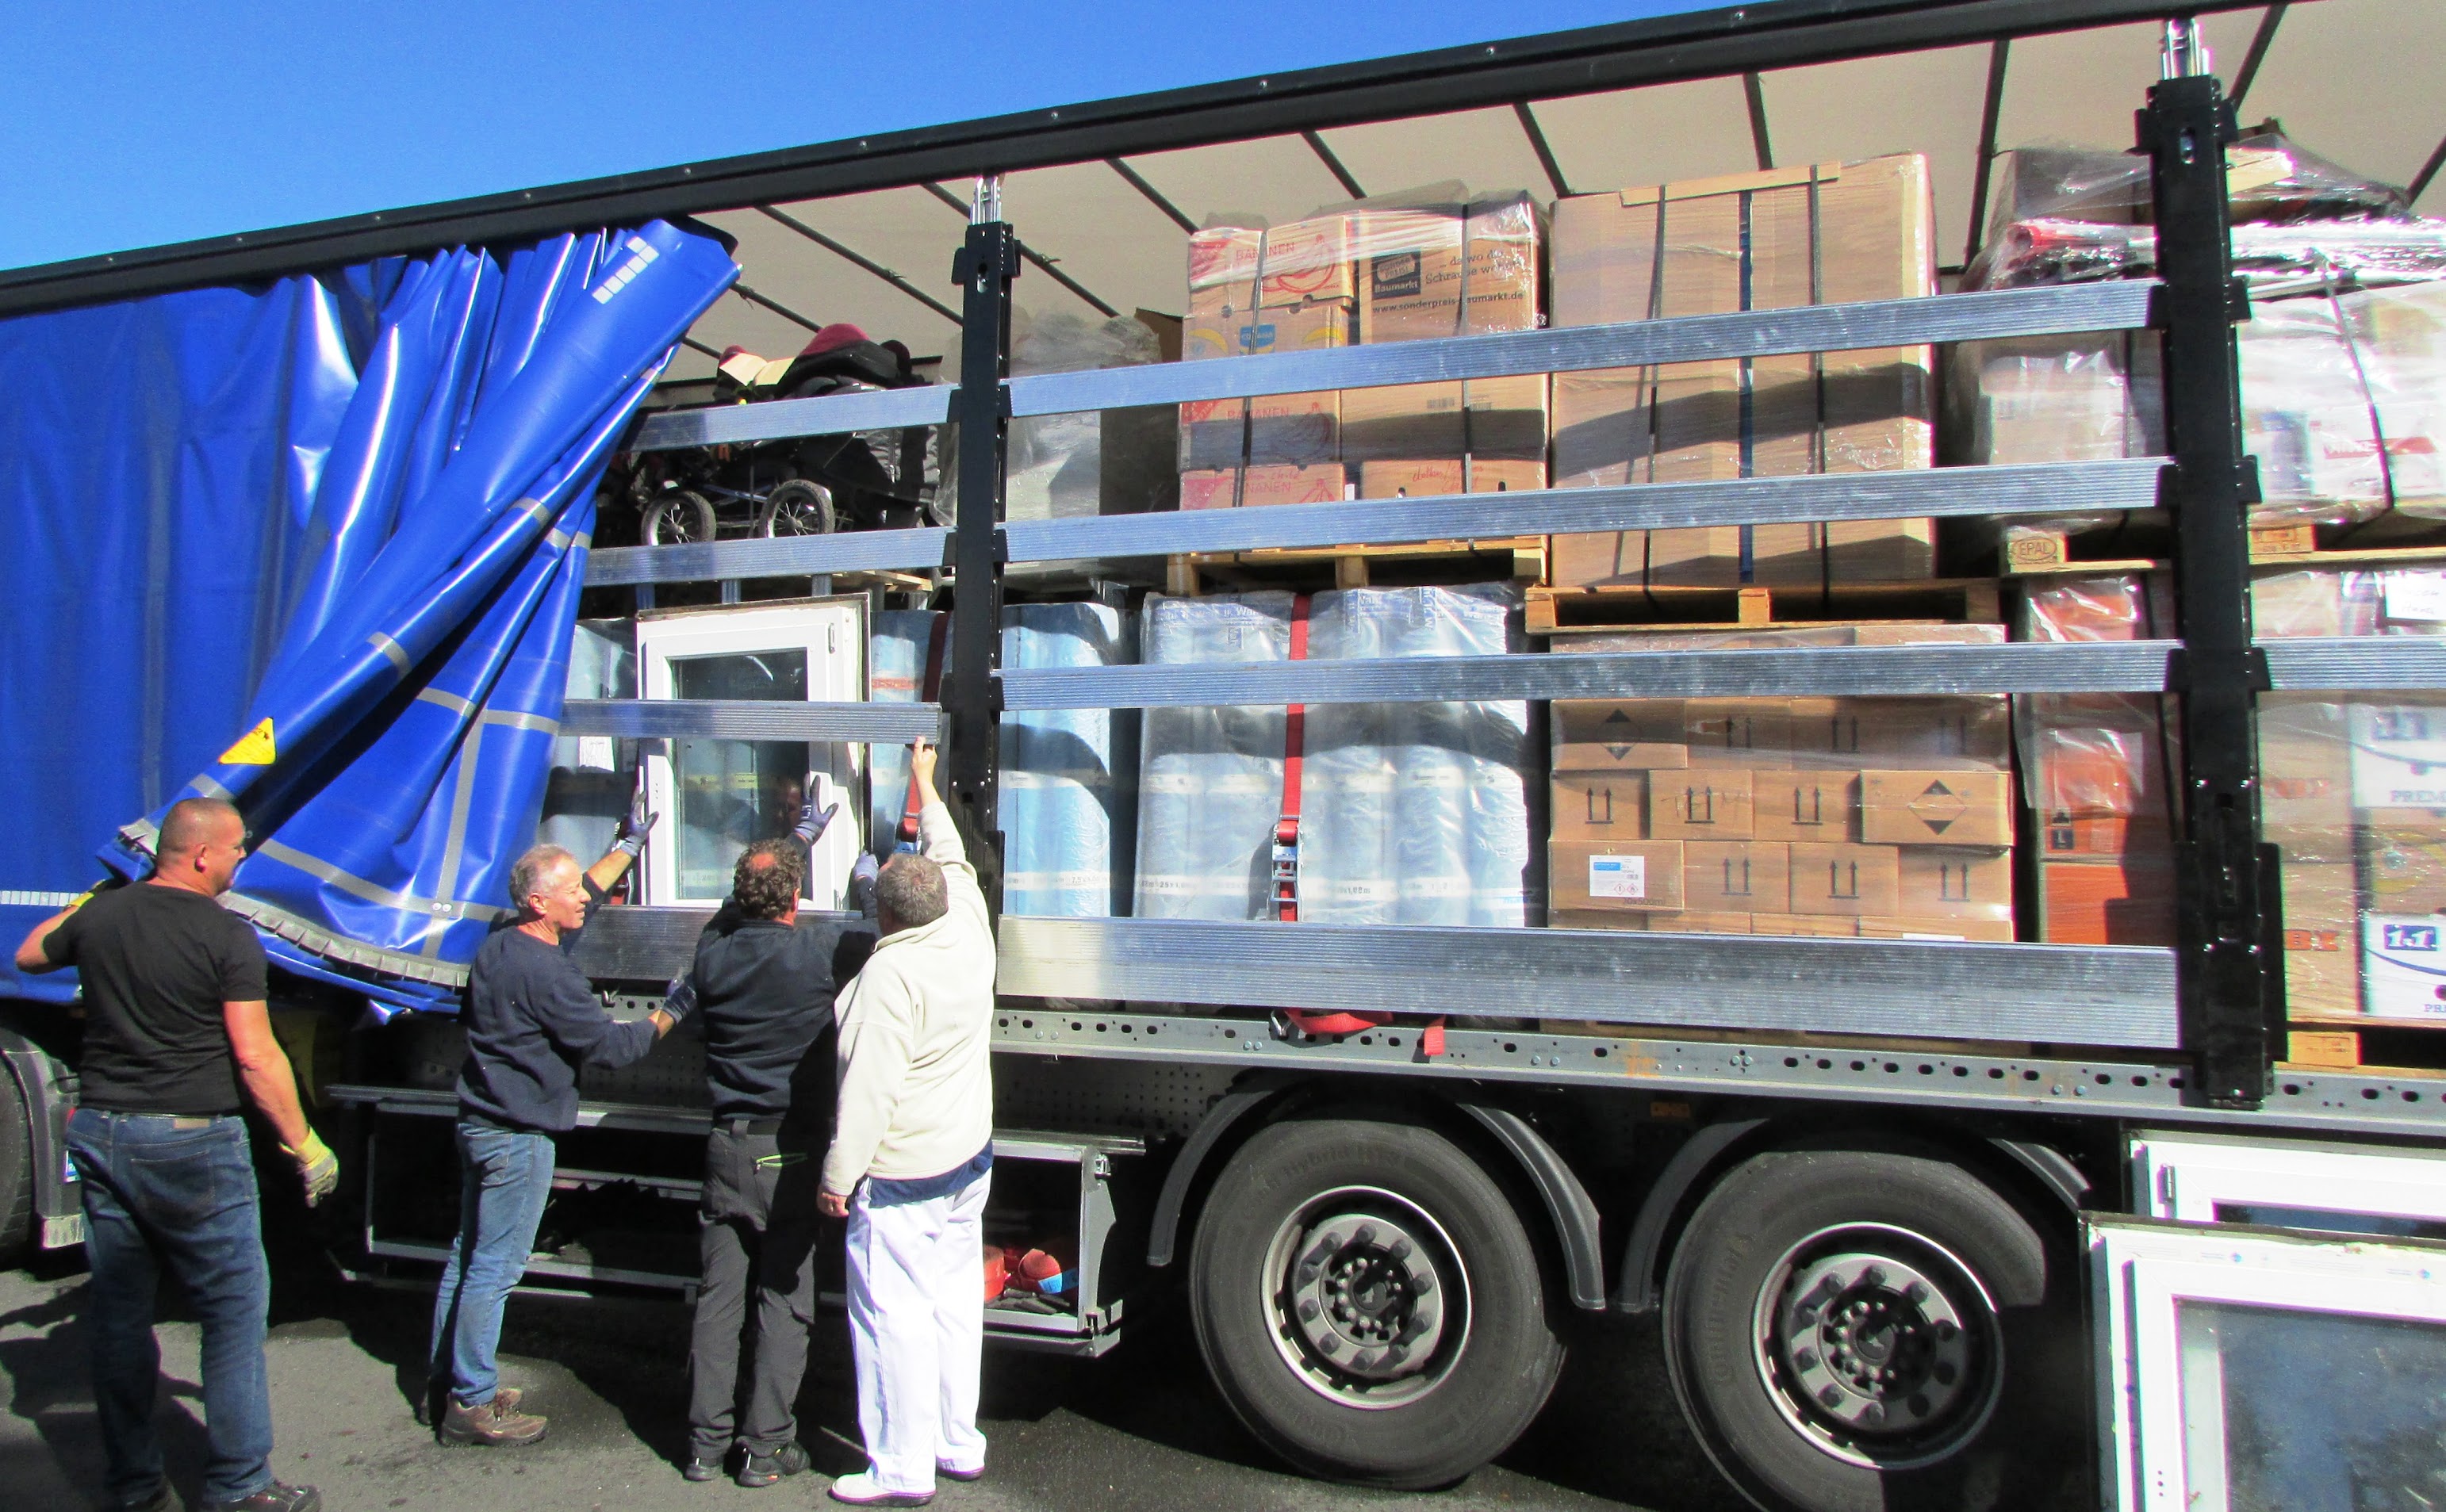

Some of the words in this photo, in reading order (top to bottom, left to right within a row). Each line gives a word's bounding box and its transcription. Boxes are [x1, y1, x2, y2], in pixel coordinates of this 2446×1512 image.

[1236, 242, 1295, 262] BANNEN
[1374, 281, 1418, 293] Baumarkt
[1373, 291, 1524, 314] www.sonderpreis-aumarkt.de
[1227, 407, 1290, 420] BAANEN
[1229, 482, 1291, 494] BNANEN
[2019, 542, 2051, 556] EPAL
